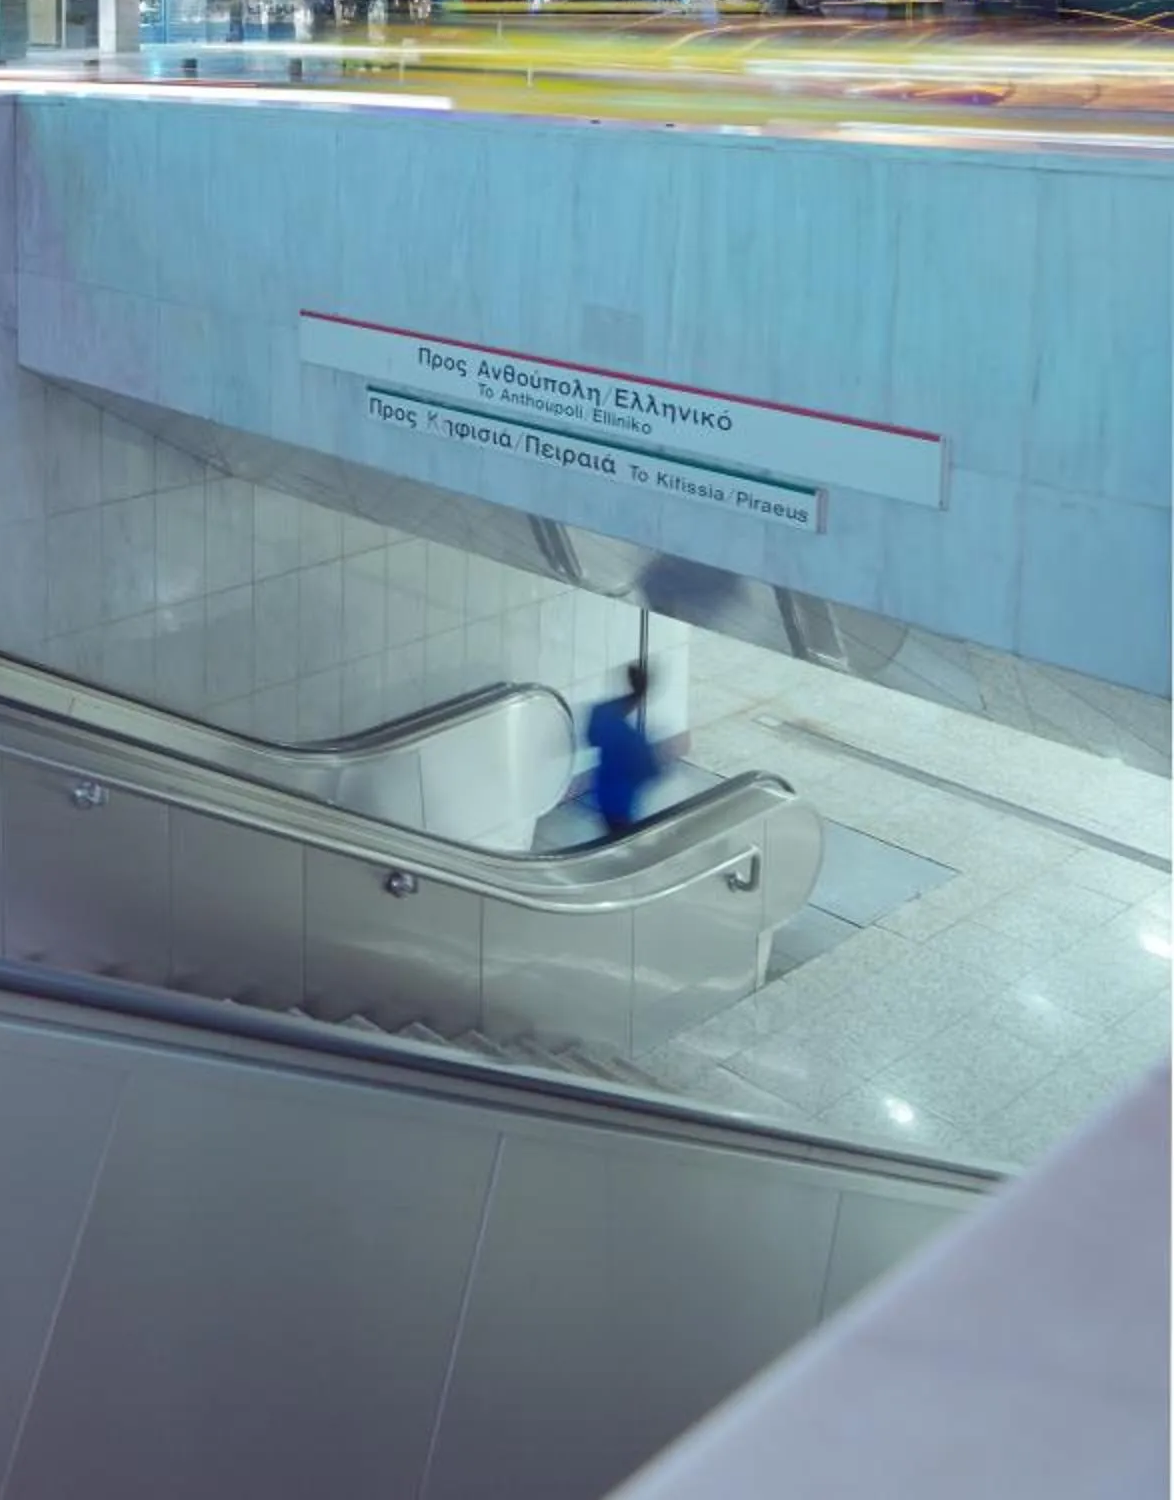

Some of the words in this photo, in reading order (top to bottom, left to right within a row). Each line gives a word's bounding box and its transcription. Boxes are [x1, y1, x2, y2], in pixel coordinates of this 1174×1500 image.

[417, 347, 468, 377] Προς
[478, 382, 495, 399] To
[368, 397, 418, 429] Προς
[629, 464, 649, 483] To
